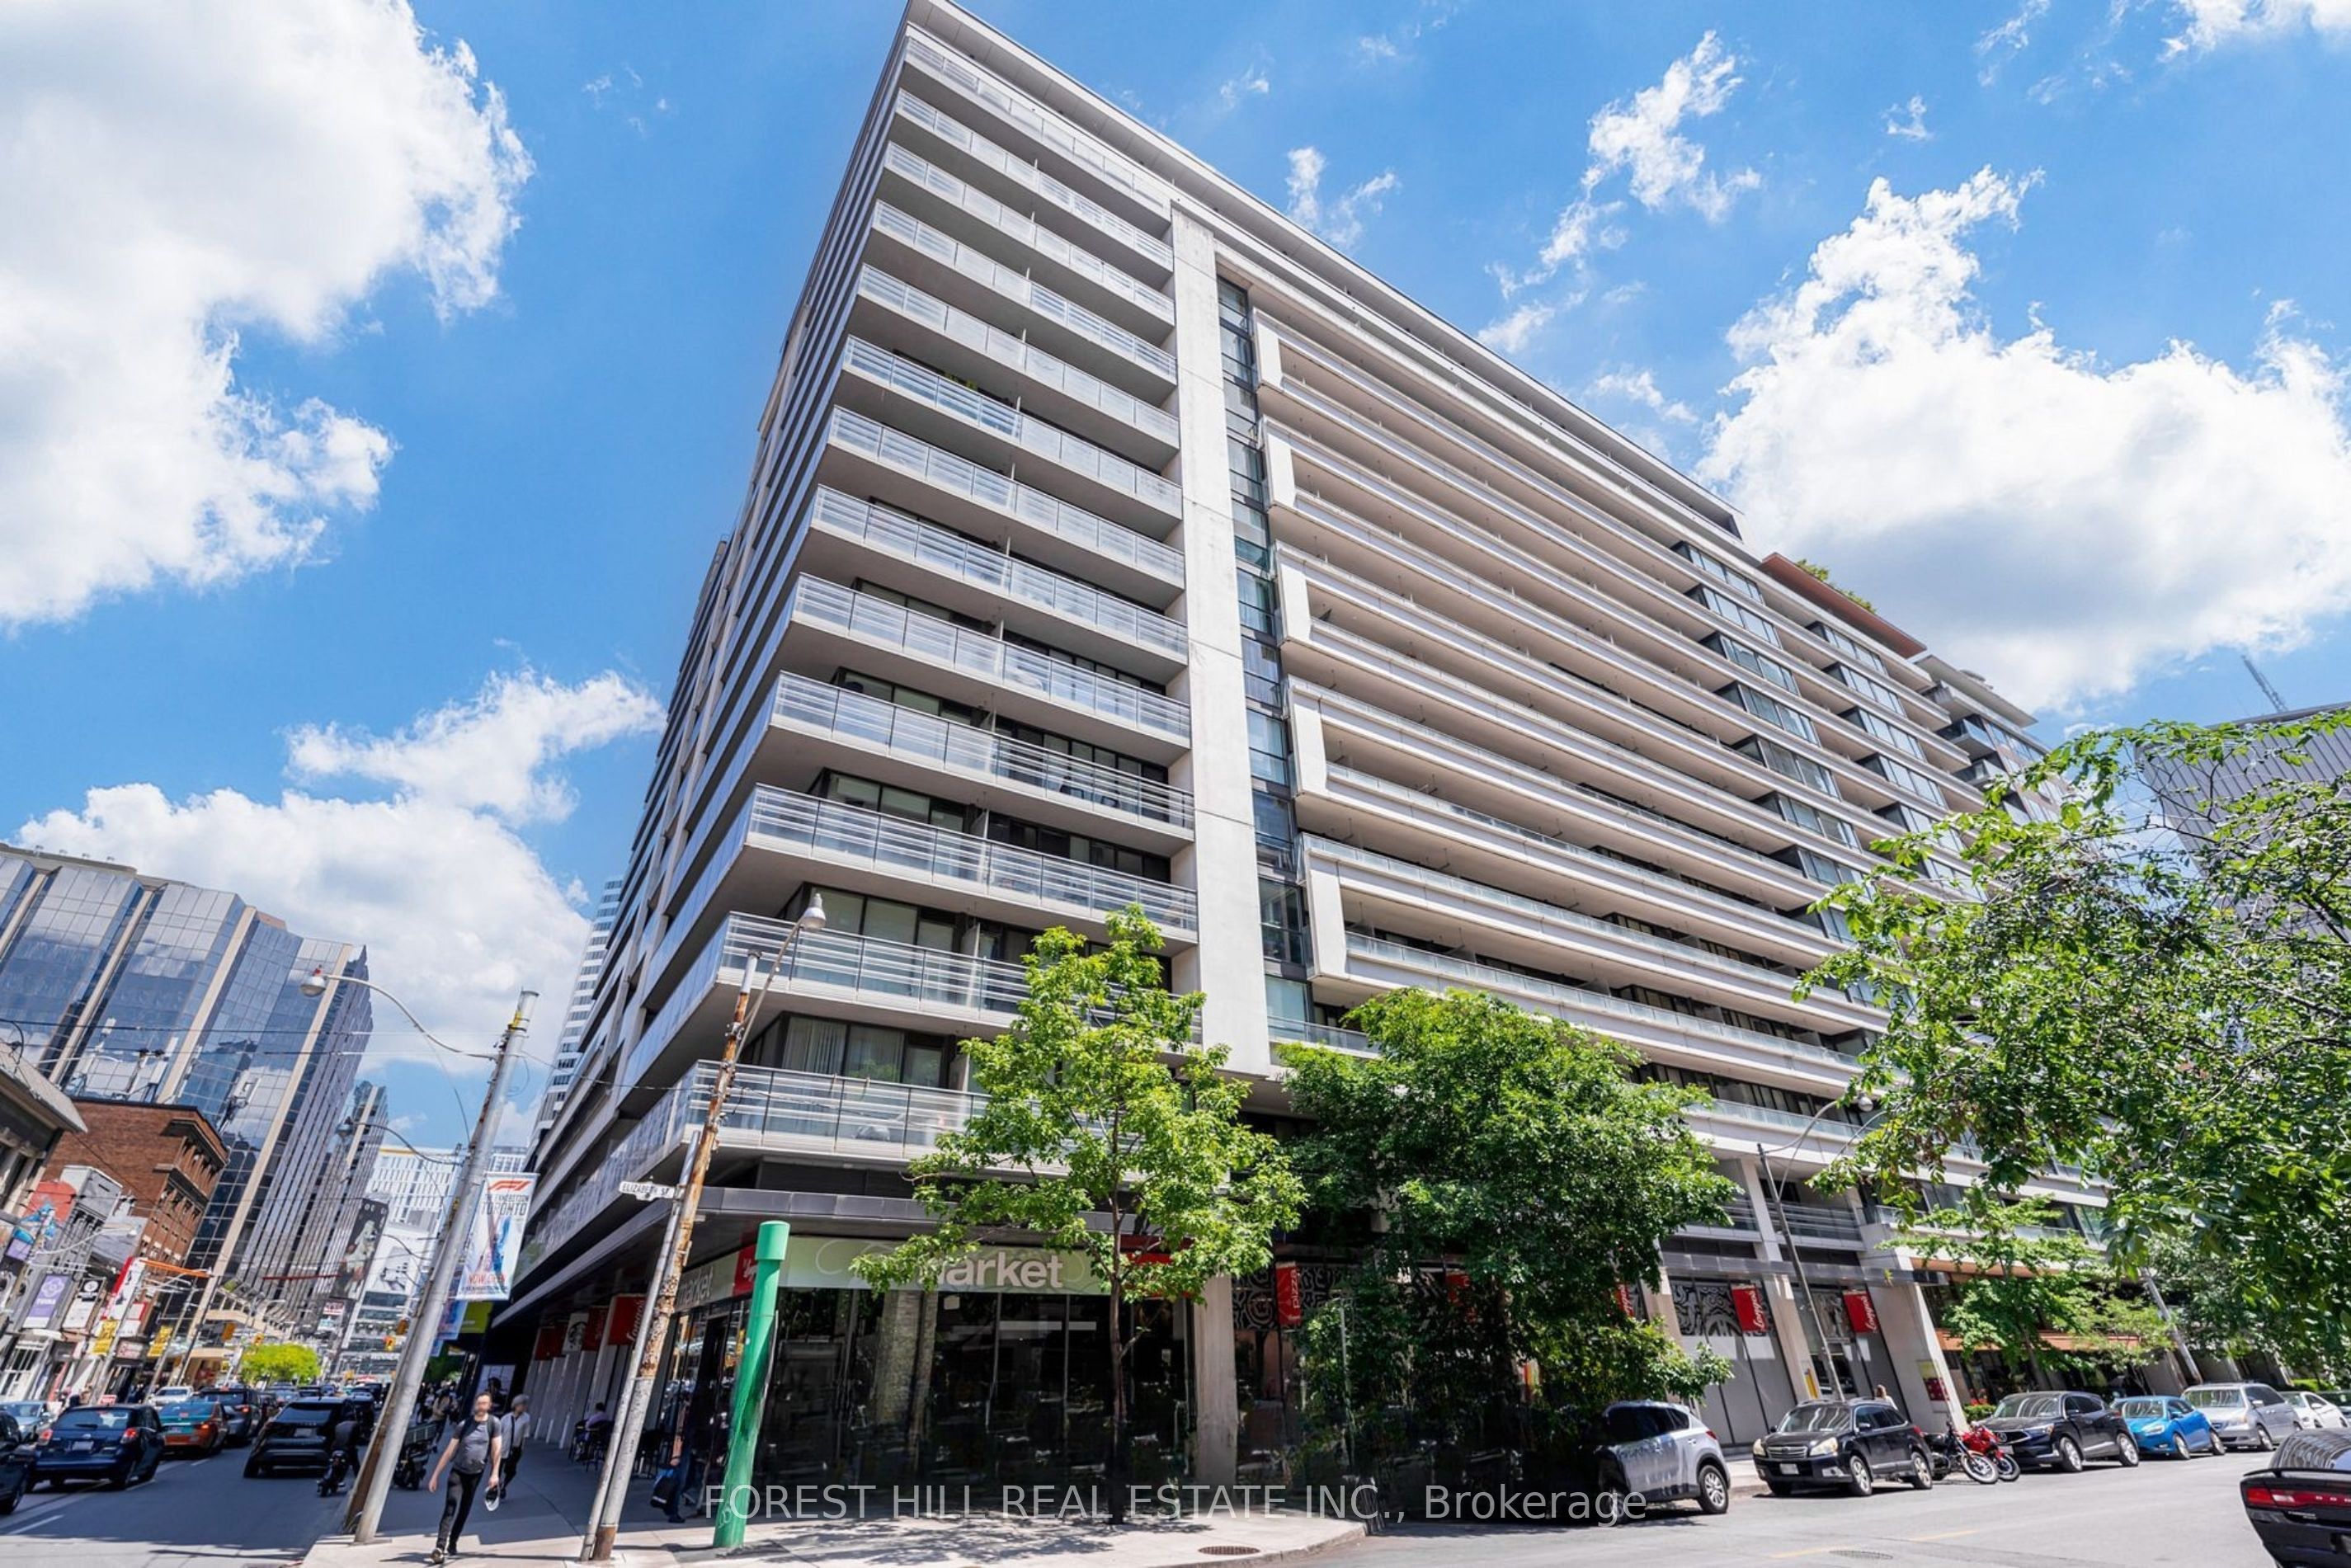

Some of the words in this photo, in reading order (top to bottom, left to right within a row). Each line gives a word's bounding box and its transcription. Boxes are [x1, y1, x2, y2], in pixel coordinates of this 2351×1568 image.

[623, 1183, 658, 1194] ELIZABETH
[481, 1202, 528, 1216] TORONTO
[1290, 1269, 1301, 1308] pizza
